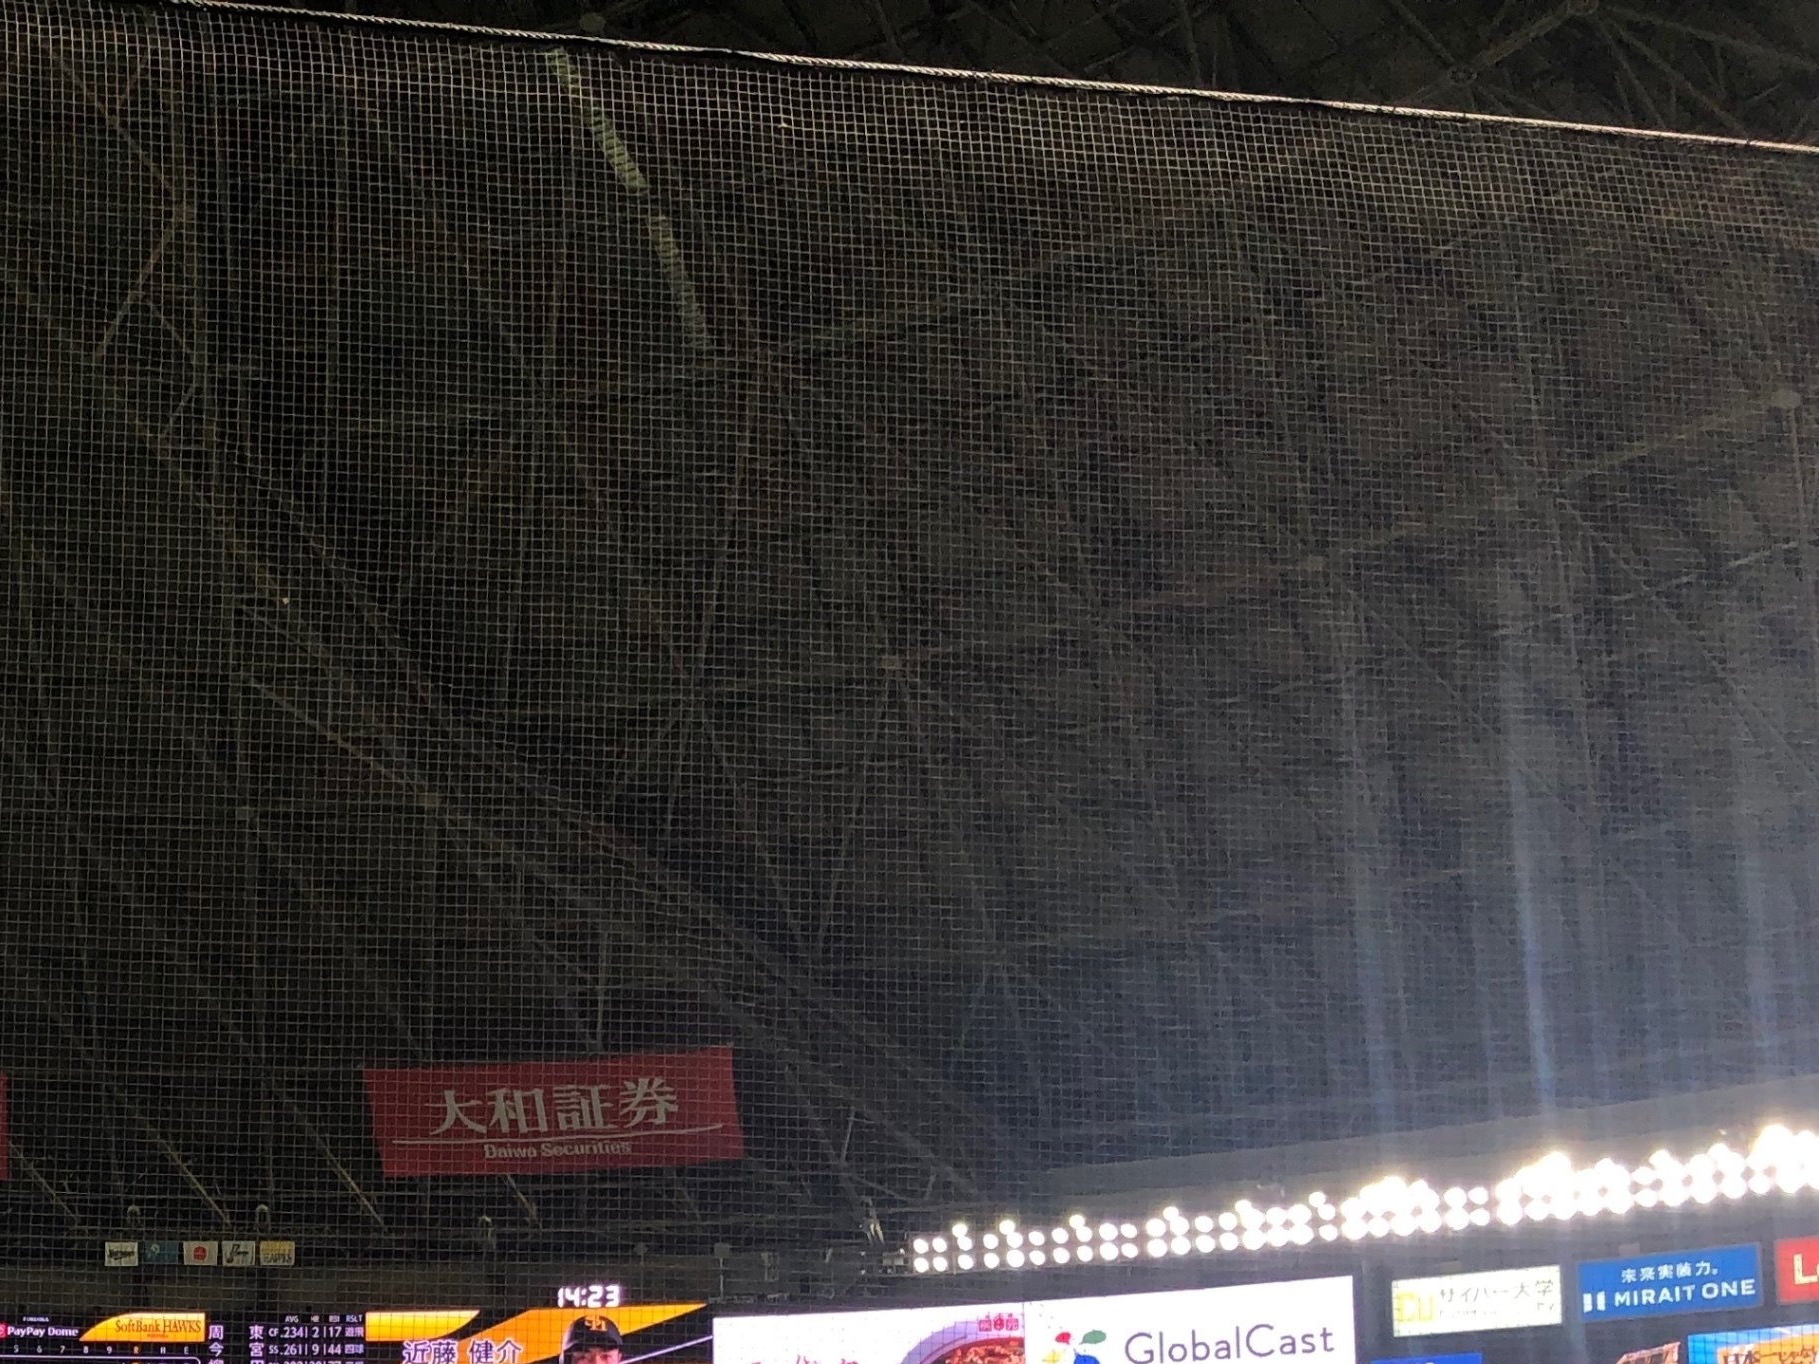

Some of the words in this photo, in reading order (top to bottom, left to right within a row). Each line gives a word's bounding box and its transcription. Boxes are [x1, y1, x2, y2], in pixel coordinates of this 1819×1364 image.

[424, 1077, 678, 1135] 大和証券
[484, 1143, 537, 1159] Daiwa
[540, 1141, 631, 1158] Securities
[557, 1285, 620, 1308] 14:23
[1614, 1284, 1696, 1308] MIRAIT
[1702, 1278, 1756, 1299] ONE
[7, 1327, 45, 1338] PayPay
[48, 1327, 79, 1337] Dome
[115, 1320, 160, 1333] SoftBank
[162, 1319, 201, 1335] HAWKS
[280, 1327, 304, 1338] .234
[280, 1344, 302, 1355] .261
[468, 1339, 522, 1364] 健介
[1125, 1324, 1335, 1364] GlobalCast
